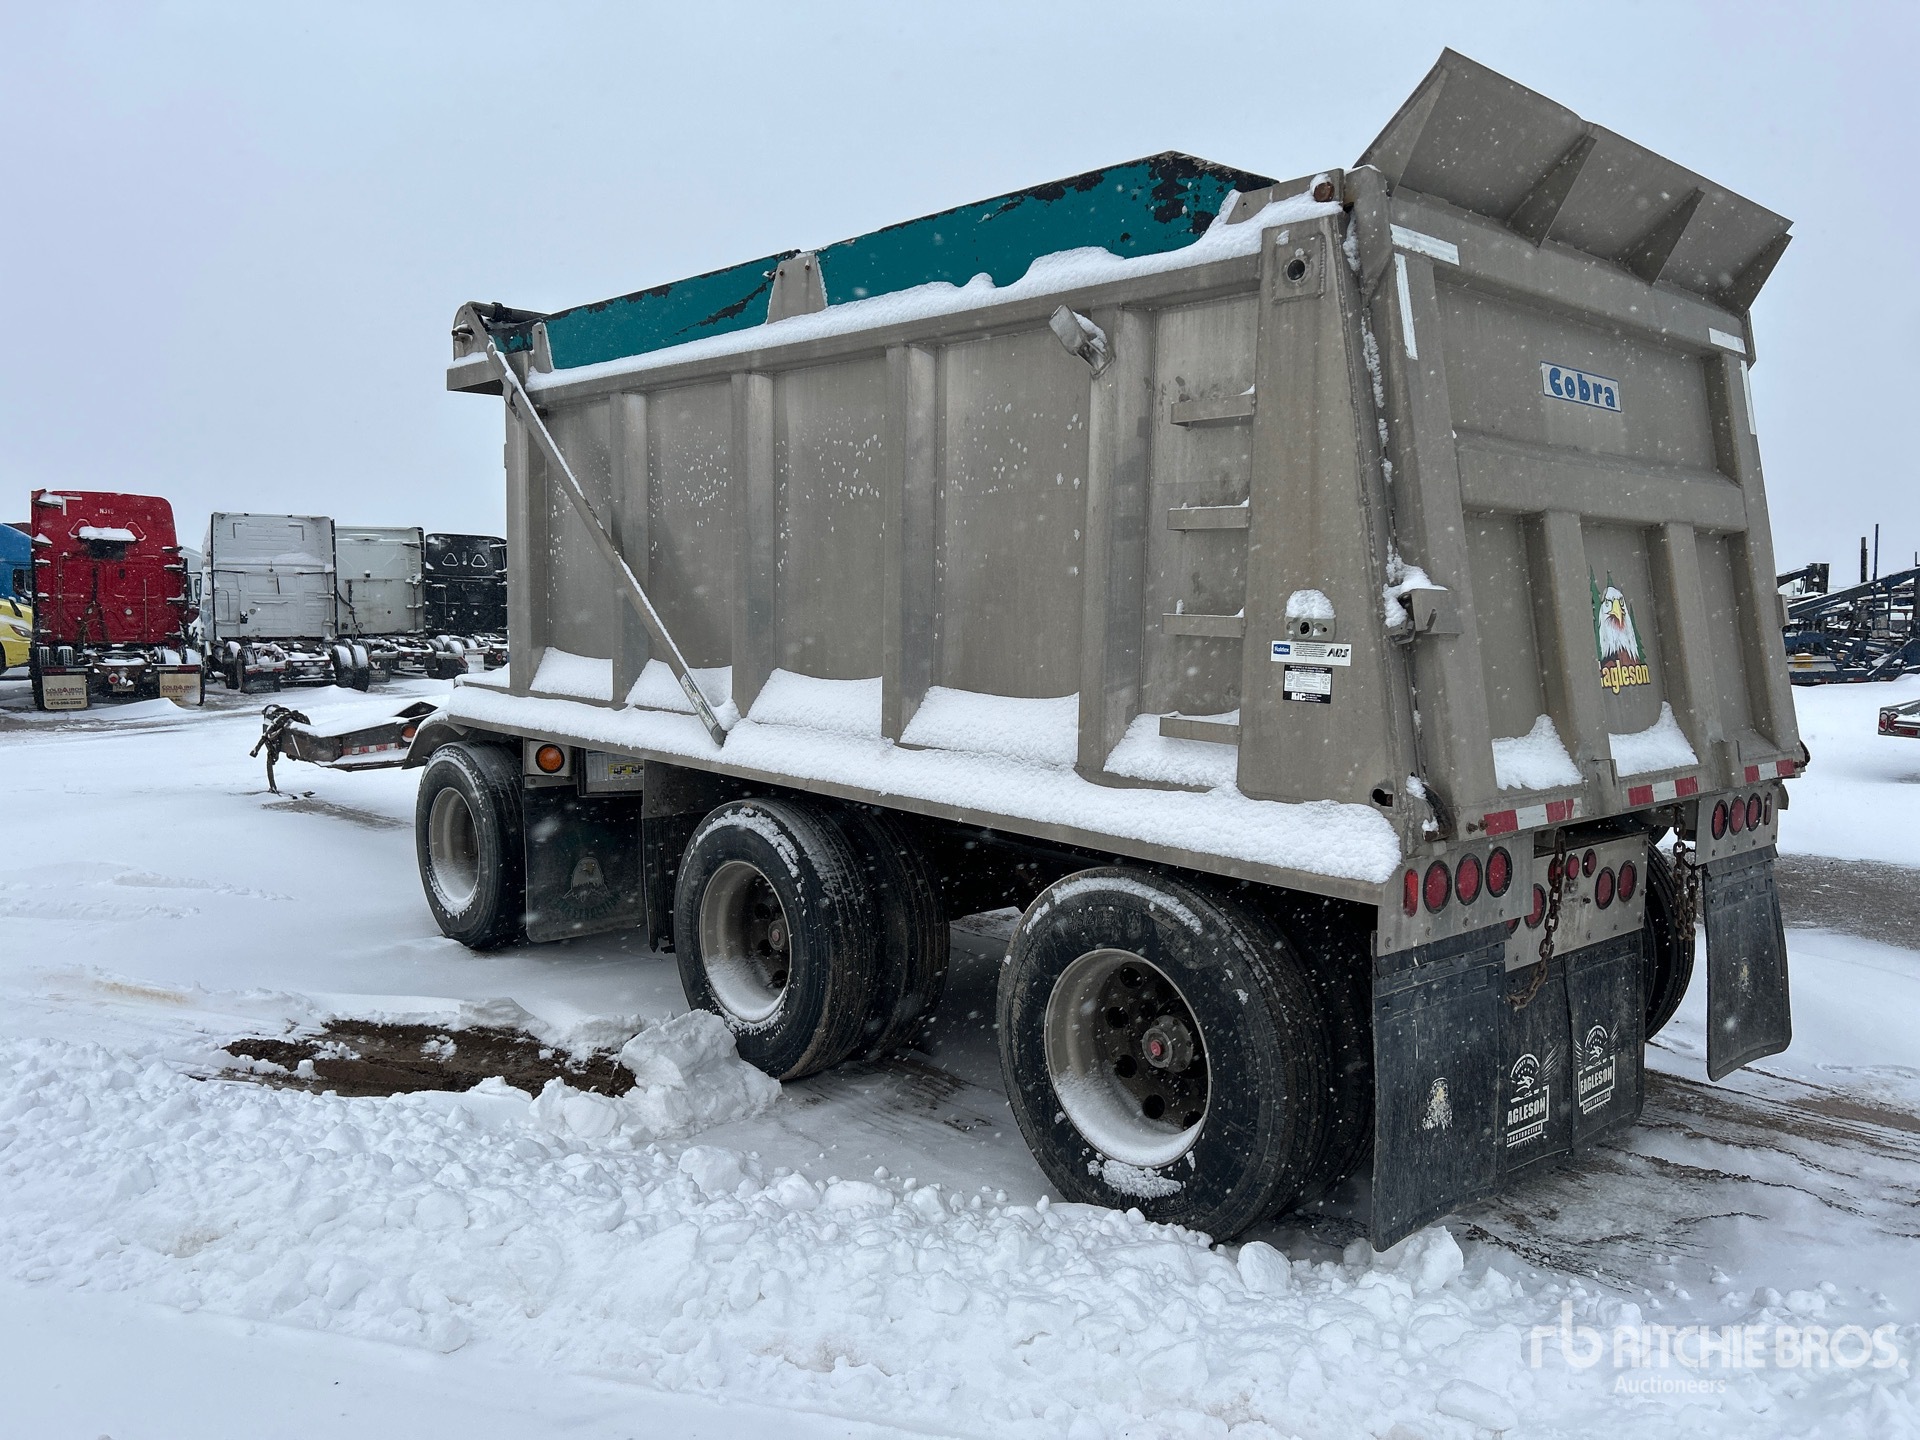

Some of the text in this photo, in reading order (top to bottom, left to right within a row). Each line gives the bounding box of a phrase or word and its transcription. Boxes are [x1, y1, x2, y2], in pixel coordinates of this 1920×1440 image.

[1549, 367, 1615, 408] Cobra
[1327, 648, 1349, 658] ABS
[1598, 659, 1651, 695] agleson
[1580, 1066, 1612, 1095] EAGLESON
[1507, 1096, 1546, 1126] AGLESON
